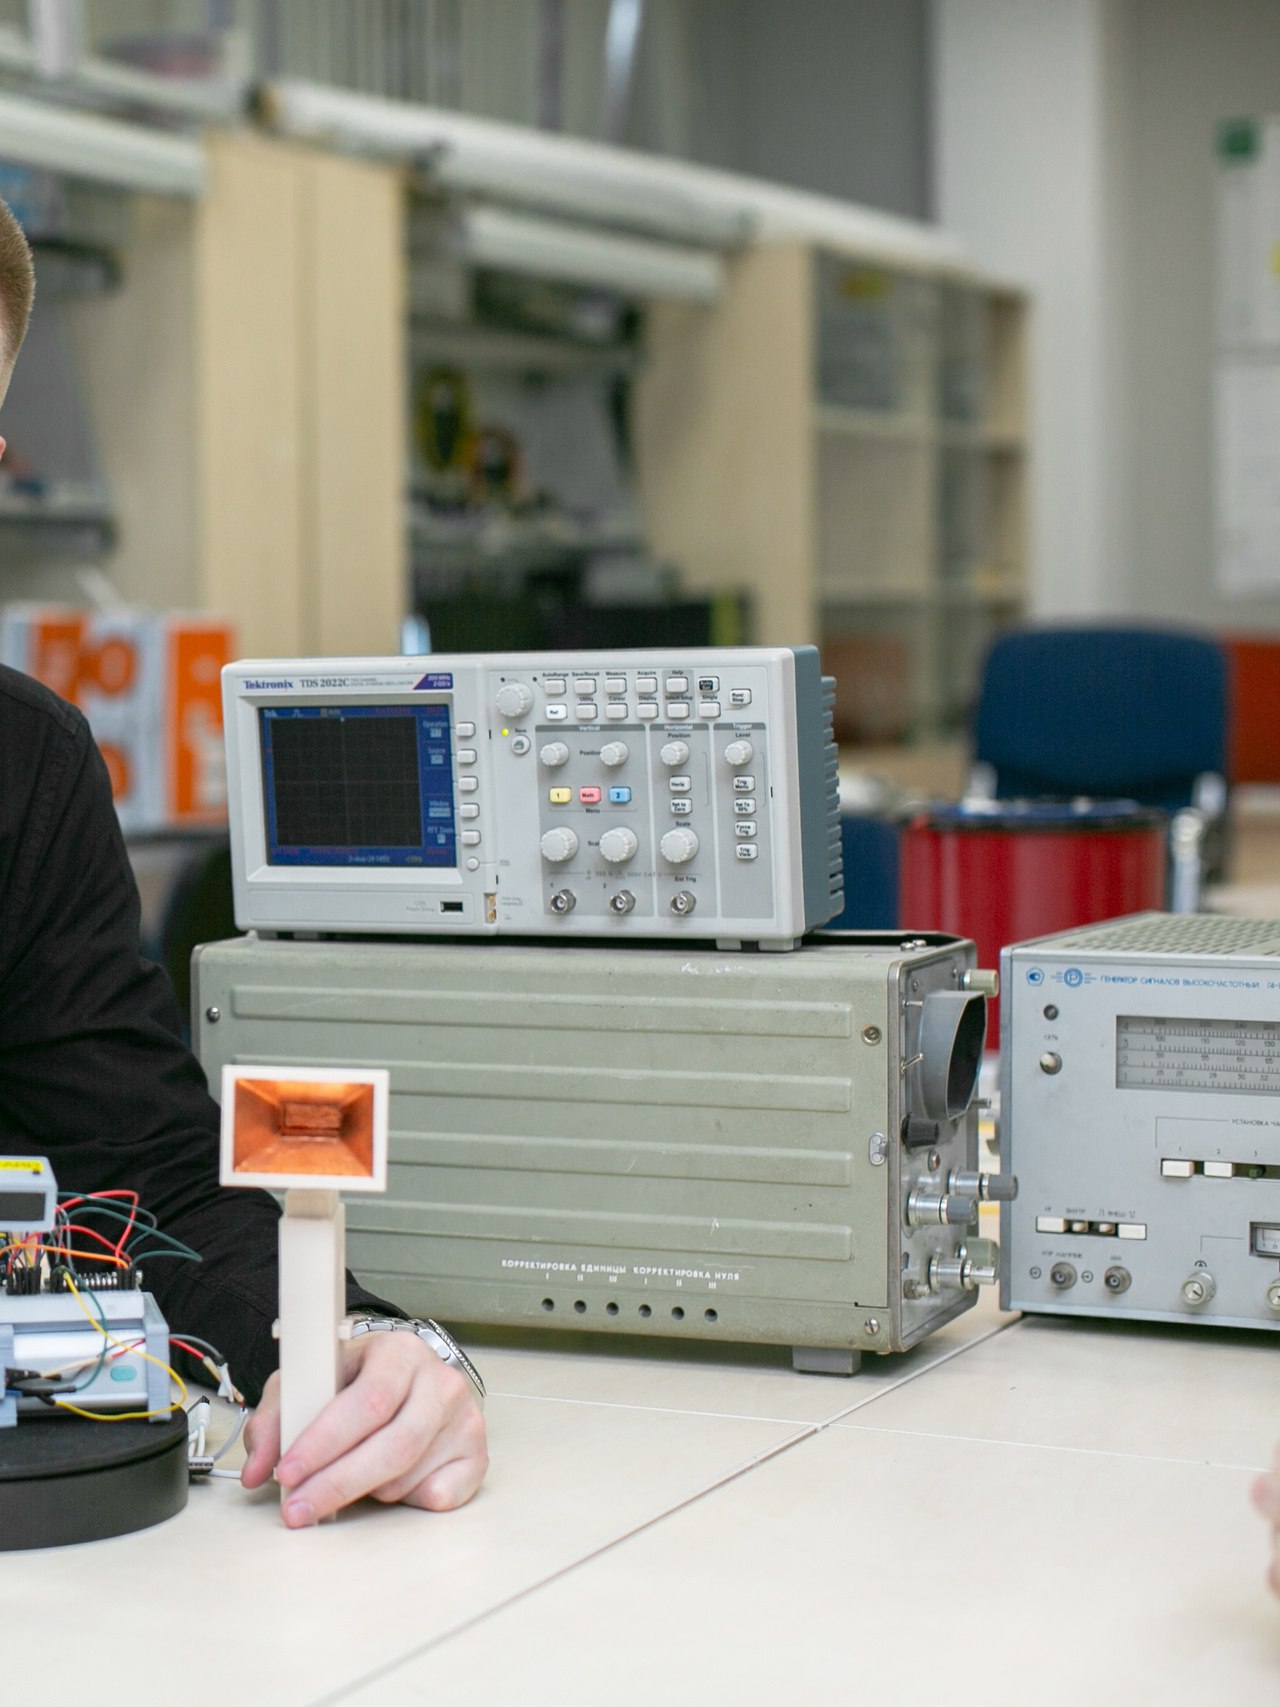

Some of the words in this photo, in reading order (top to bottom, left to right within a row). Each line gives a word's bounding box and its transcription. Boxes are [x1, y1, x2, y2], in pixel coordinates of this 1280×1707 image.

[244, 680, 294, 691] Tektronix
[300, 680, 319, 689] TDS
[320, 678, 350, 688] 2022C
[1100, 975, 1138, 984] ГЕНЕРАТОР
[1140, 977, 1180, 986] СИГНАЛОВ
[1231, 1119, 1269, 1127] УСТАНОВКА
[501, 1259, 577, 1272] КОРРЕКТИРОВКА
[581, 1263, 627, 1275] ЕДИНИЦЫ
[633, 1266, 711, 1279] КОРРЕКТИРОВКА
[714, 1271, 740, 1281] НУЛЯ
[608, 1275, 618, 1283] III
